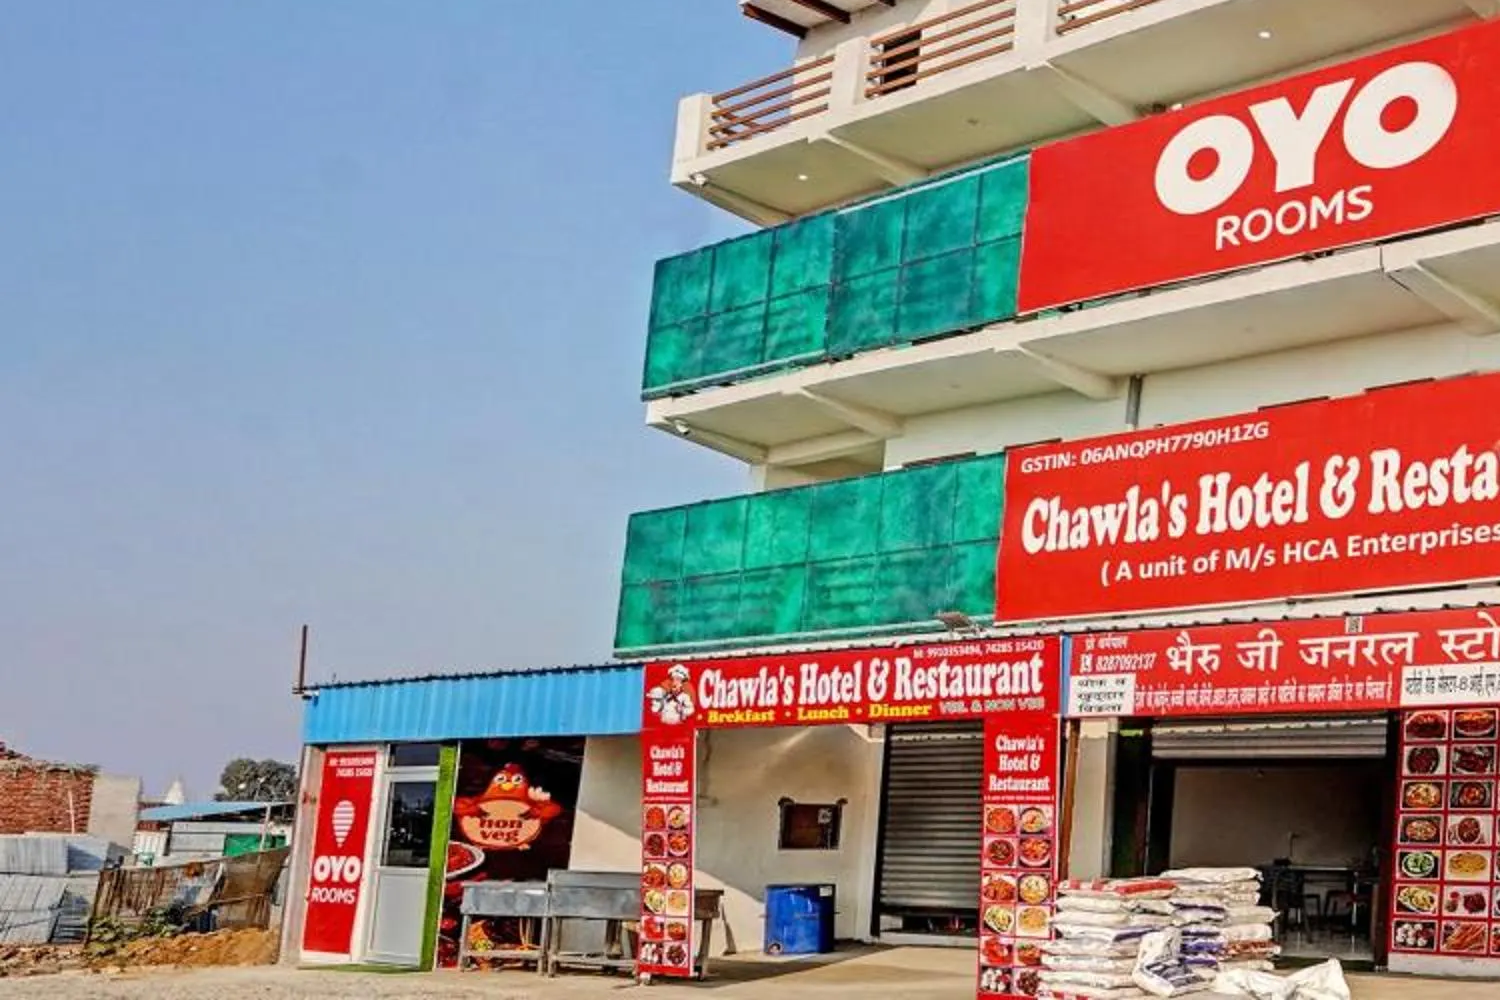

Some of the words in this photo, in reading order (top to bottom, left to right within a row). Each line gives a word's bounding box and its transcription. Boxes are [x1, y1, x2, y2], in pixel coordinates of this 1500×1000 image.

[1155, 61, 1457, 214] OYO
[1215, 185, 1373, 250] ROOMS
[1021, 451, 1076, 473] GSTIN:
[1021, 480, 1188, 555] Chawla's
[1196, 459, 1309, 535] Hotel
[1318, 453, 1360, 518] &
[1139, 556, 1186, 579] unit
[1192, 551, 1217, 575] of
[1225, 546, 1276, 573] M/s
[1283, 539, 1339, 566] HCA
[1236, 628, 1284, 672] जी
[1299, 632, 1419, 668] जनरल
[698, 664, 795, 709] Chawla's
[798, 660, 863, 705] Hotel
[867, 657, 890, 702] &
[893, 651, 1044, 701] Restaurant
[797, 705, 849, 720] Lunch
[869, 703, 932, 718] Dinner
[999, 753, 1029, 771] Hotel
[989, 773, 1050, 791] Restaurant
[479, 819, 523, 828] non
[479, 830, 520, 842] veg
[313, 855, 361, 883] OYO
[309, 888, 356, 905] ROOMS
